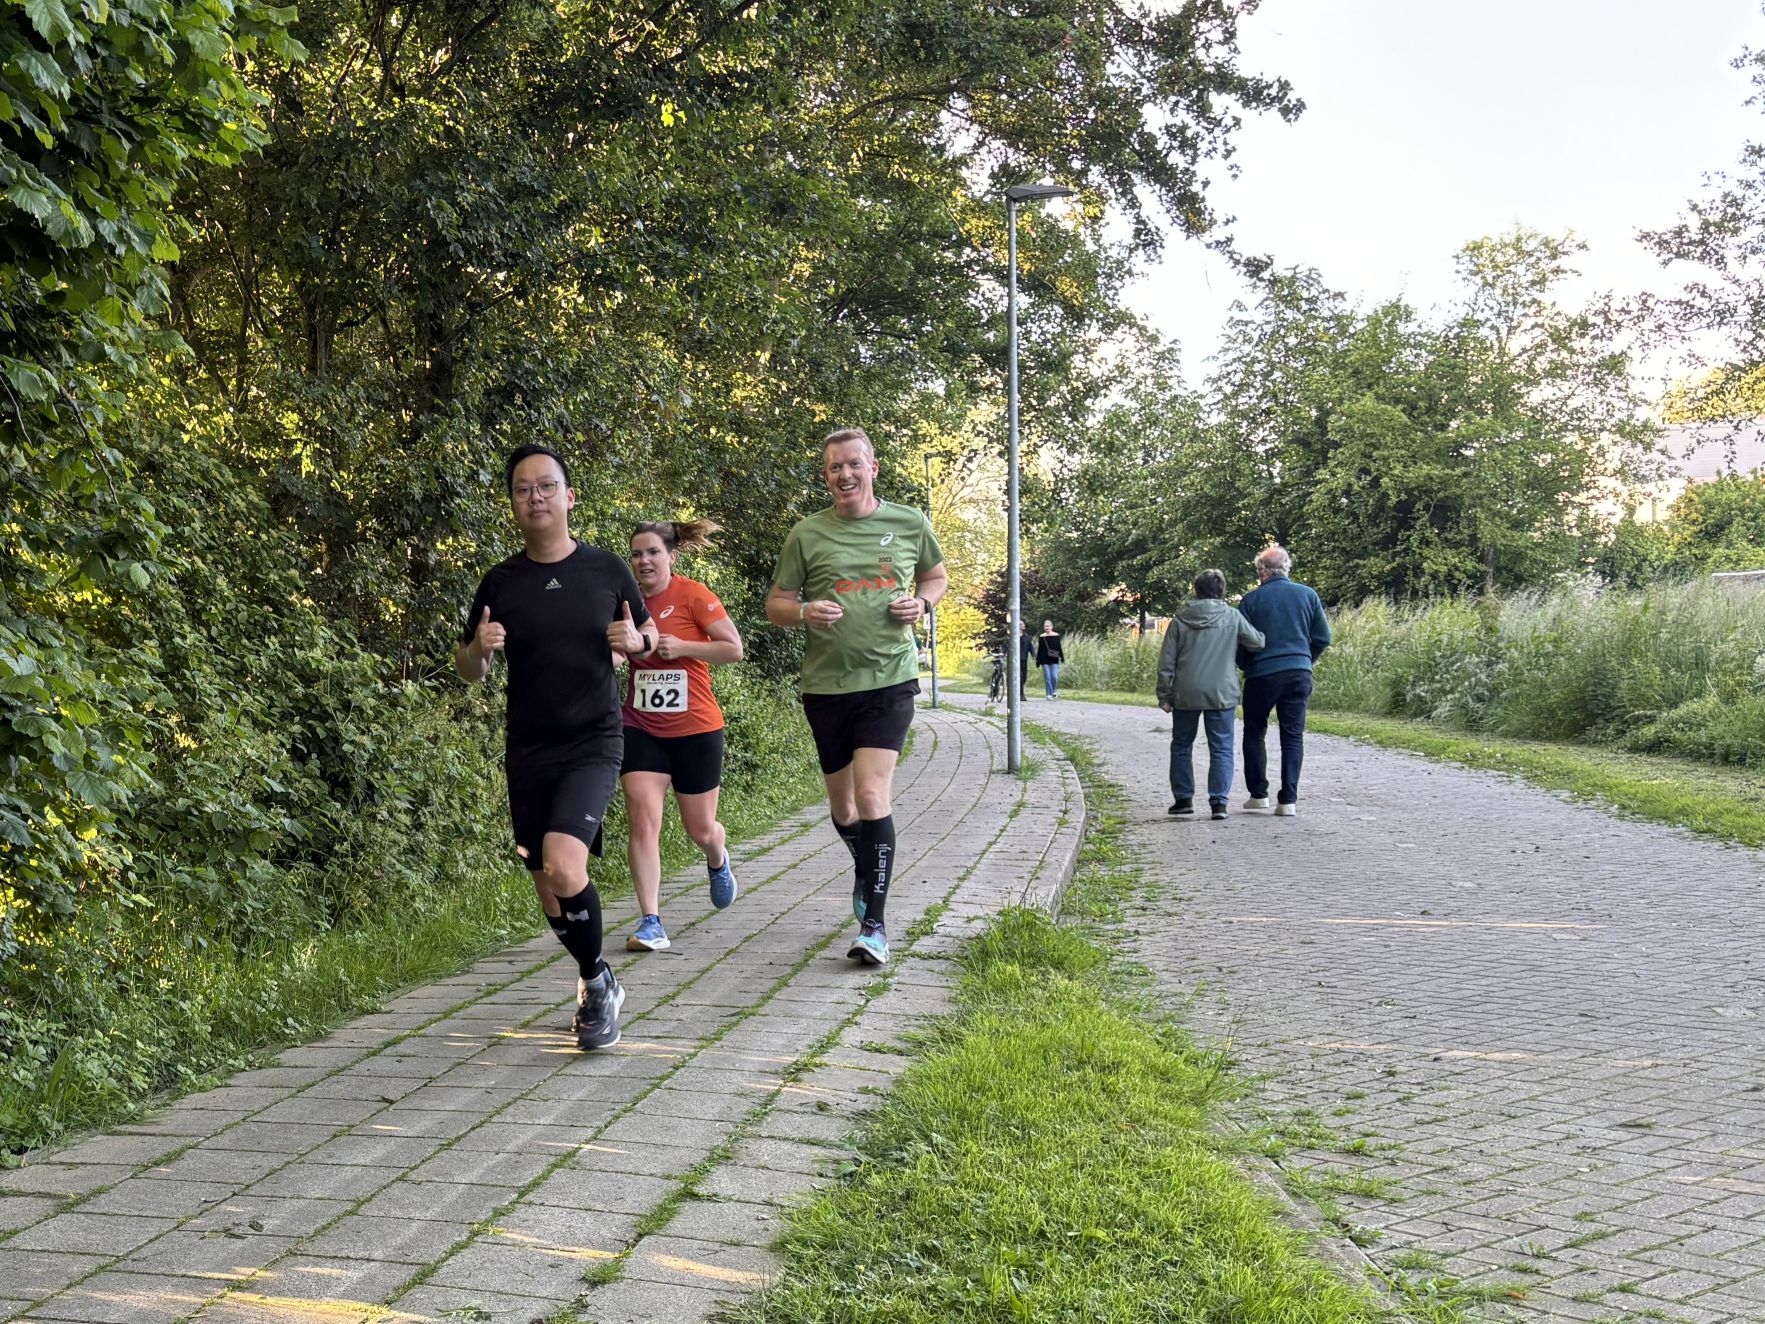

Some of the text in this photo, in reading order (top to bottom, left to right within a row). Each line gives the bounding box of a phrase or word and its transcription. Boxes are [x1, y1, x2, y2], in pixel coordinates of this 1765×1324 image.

[835, 577, 896, 593] DAM
[638, 673, 681, 682] MYLAPS
[640, 688, 680, 708] 162
